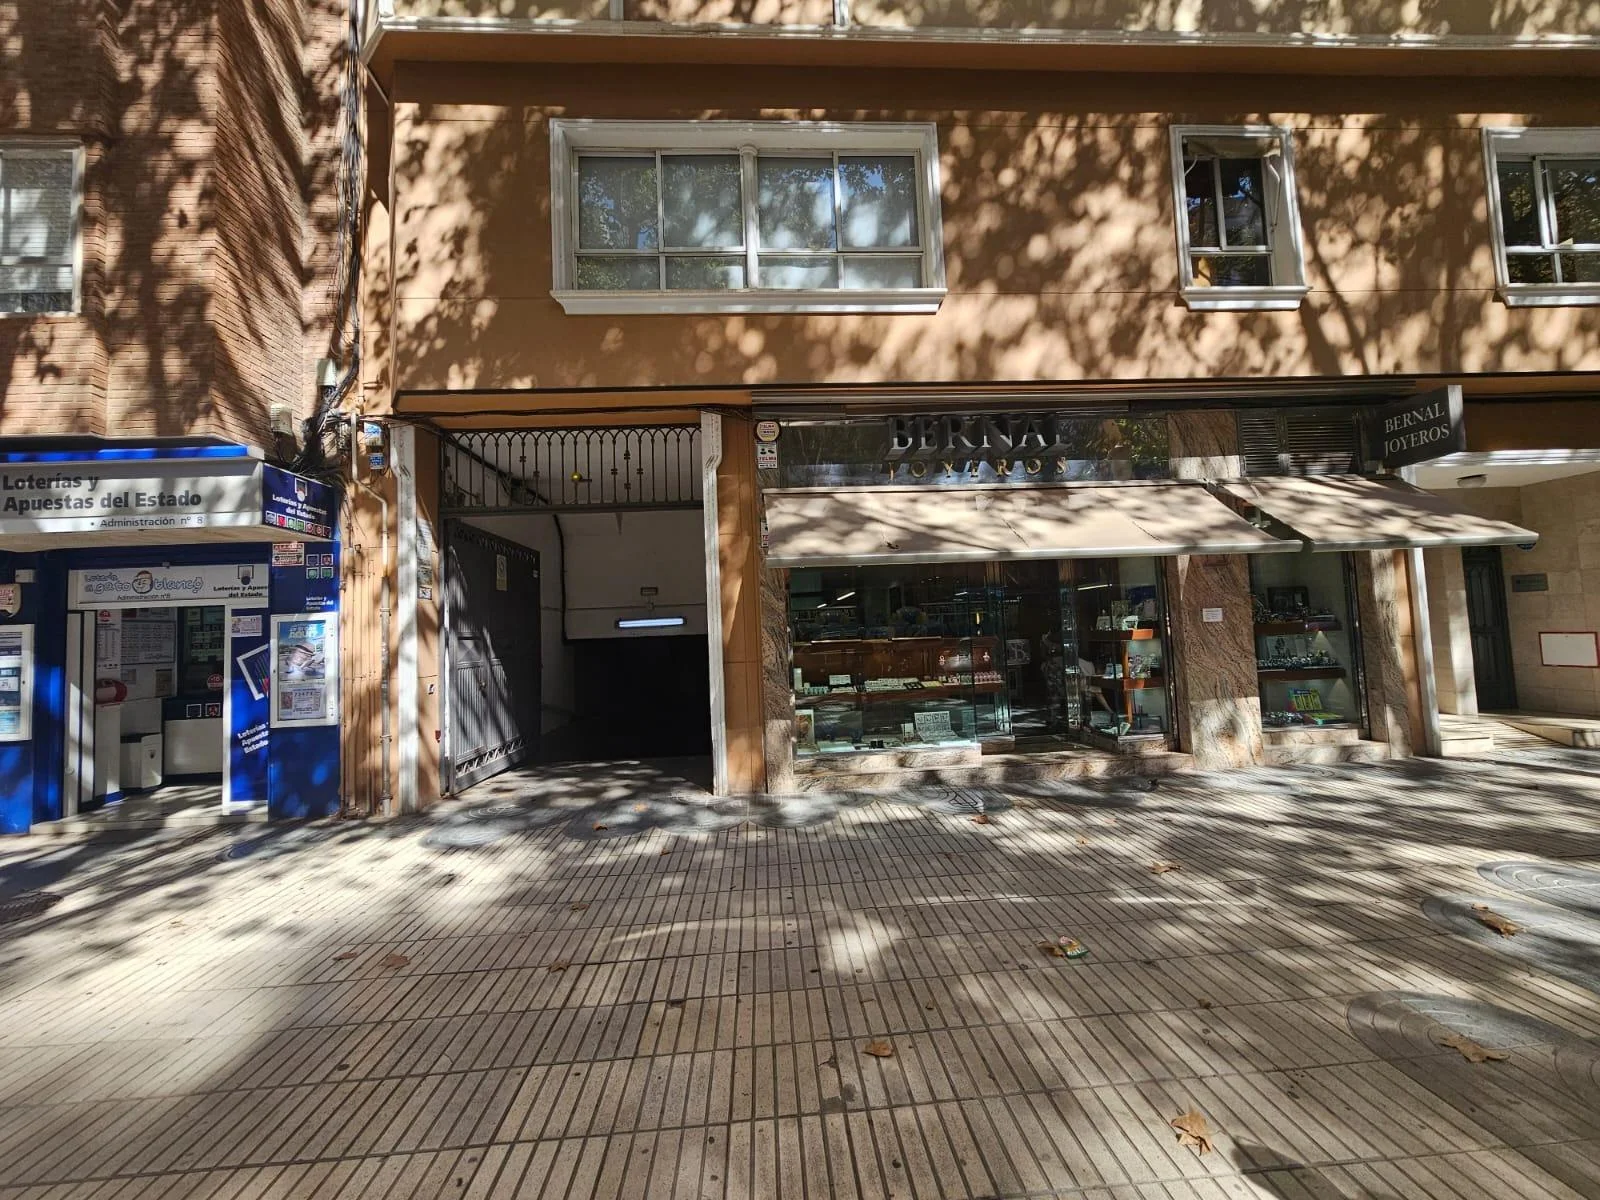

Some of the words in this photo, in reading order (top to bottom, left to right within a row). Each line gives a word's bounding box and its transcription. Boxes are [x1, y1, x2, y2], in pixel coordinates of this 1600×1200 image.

[1384, 402, 1445, 433] BERNAL
[888, 415, 1072, 450] BERNAL
[1384, 423, 1450, 458] JOYEROS
[888, 456, 1069, 481] JOYEROS
[3, 472, 82, 491] Loterías
[88, 476, 99, 492] y
[3, 494, 94, 515] Apuestas
[100, 491, 129, 509] del
[135, 489, 202, 508] Estado
[101, 517, 175, 528] Administración
[154, 576, 204, 594] blanco
